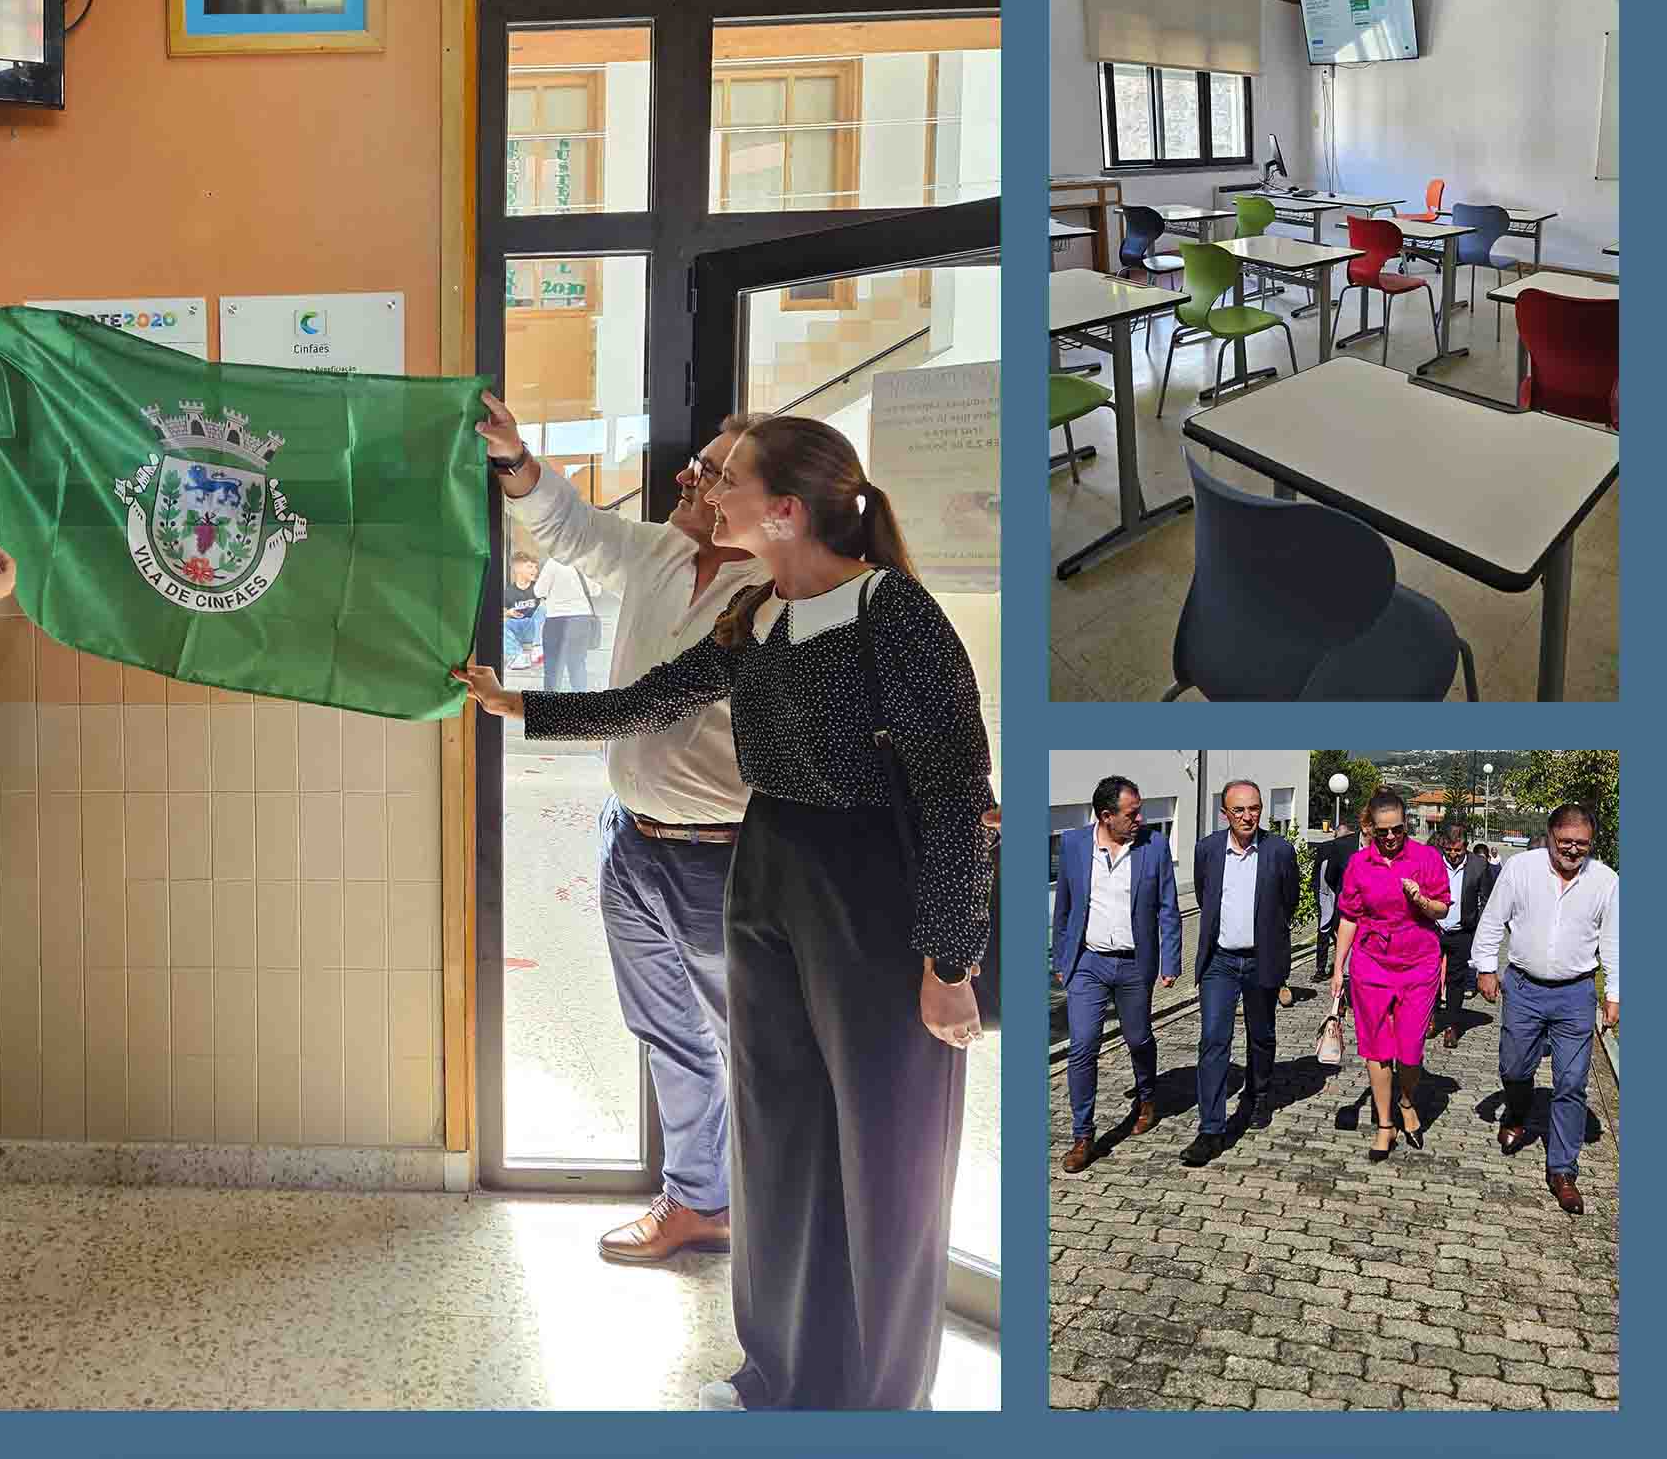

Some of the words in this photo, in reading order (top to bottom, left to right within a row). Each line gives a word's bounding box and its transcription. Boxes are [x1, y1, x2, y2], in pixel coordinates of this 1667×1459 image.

[293, 342, 330, 354] Cinfães
[134, 545, 163, 587] VILA
[164, 582, 192, 604] DE
[195, 575, 268, 609] CINFÃES
